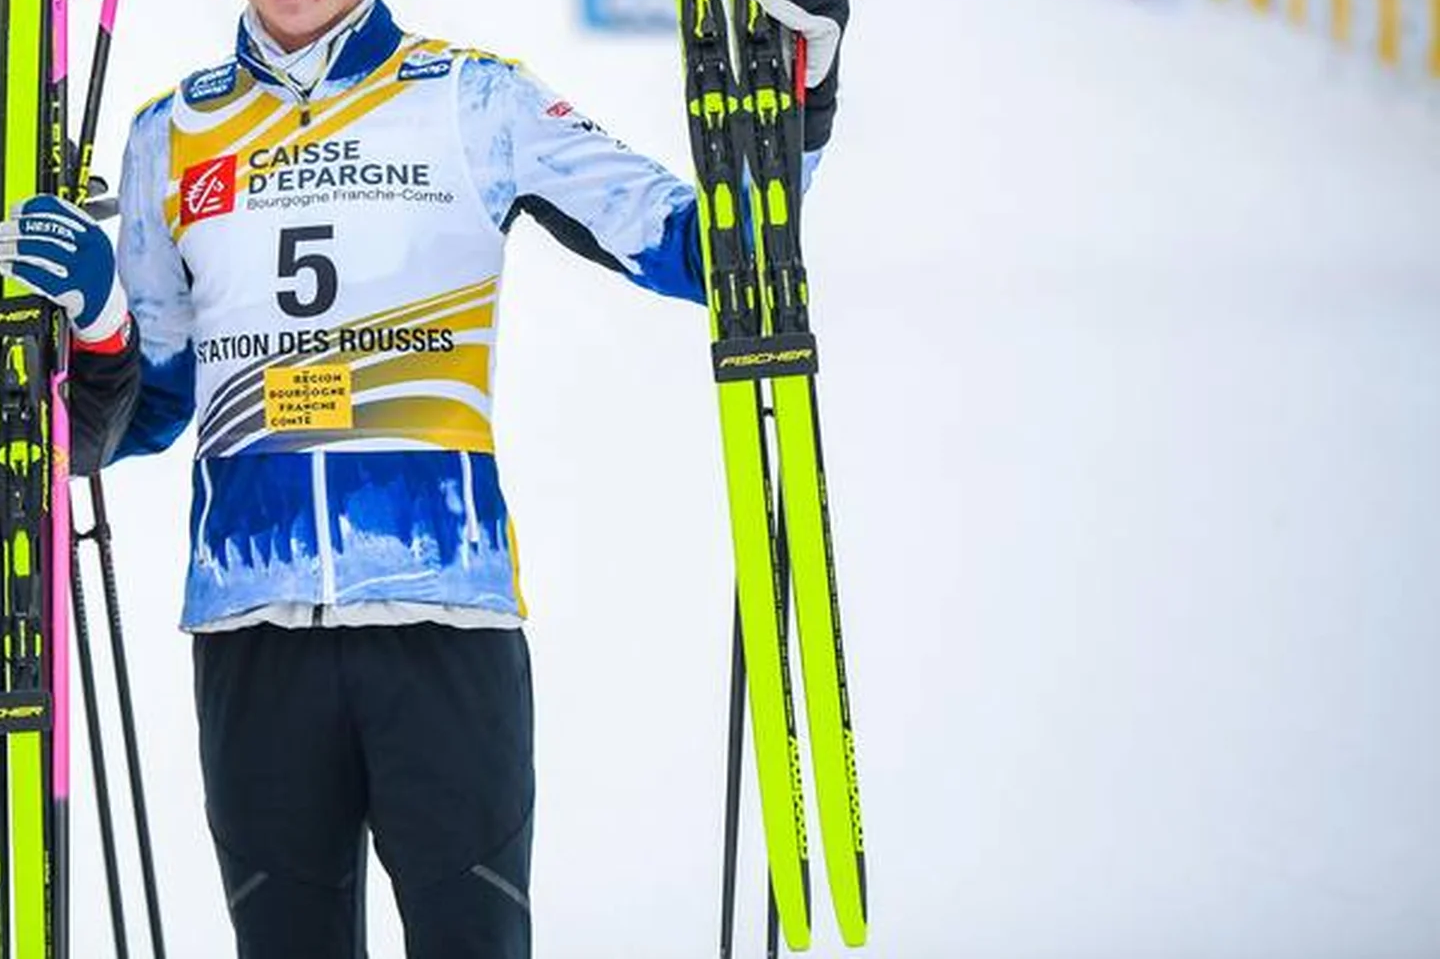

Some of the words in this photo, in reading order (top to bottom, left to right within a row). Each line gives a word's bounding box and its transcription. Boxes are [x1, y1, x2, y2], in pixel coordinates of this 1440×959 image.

[249, 140, 361, 169] CAISSE
[248, 163, 430, 195] D'EPARGNE
[247, 193, 330, 210] Bourgogne
[276, 224, 339, 318] 5
[276, 329, 330, 355] DES
[340, 327, 455, 354] ROUSSES
[720, 348, 813, 367] FISCHER
